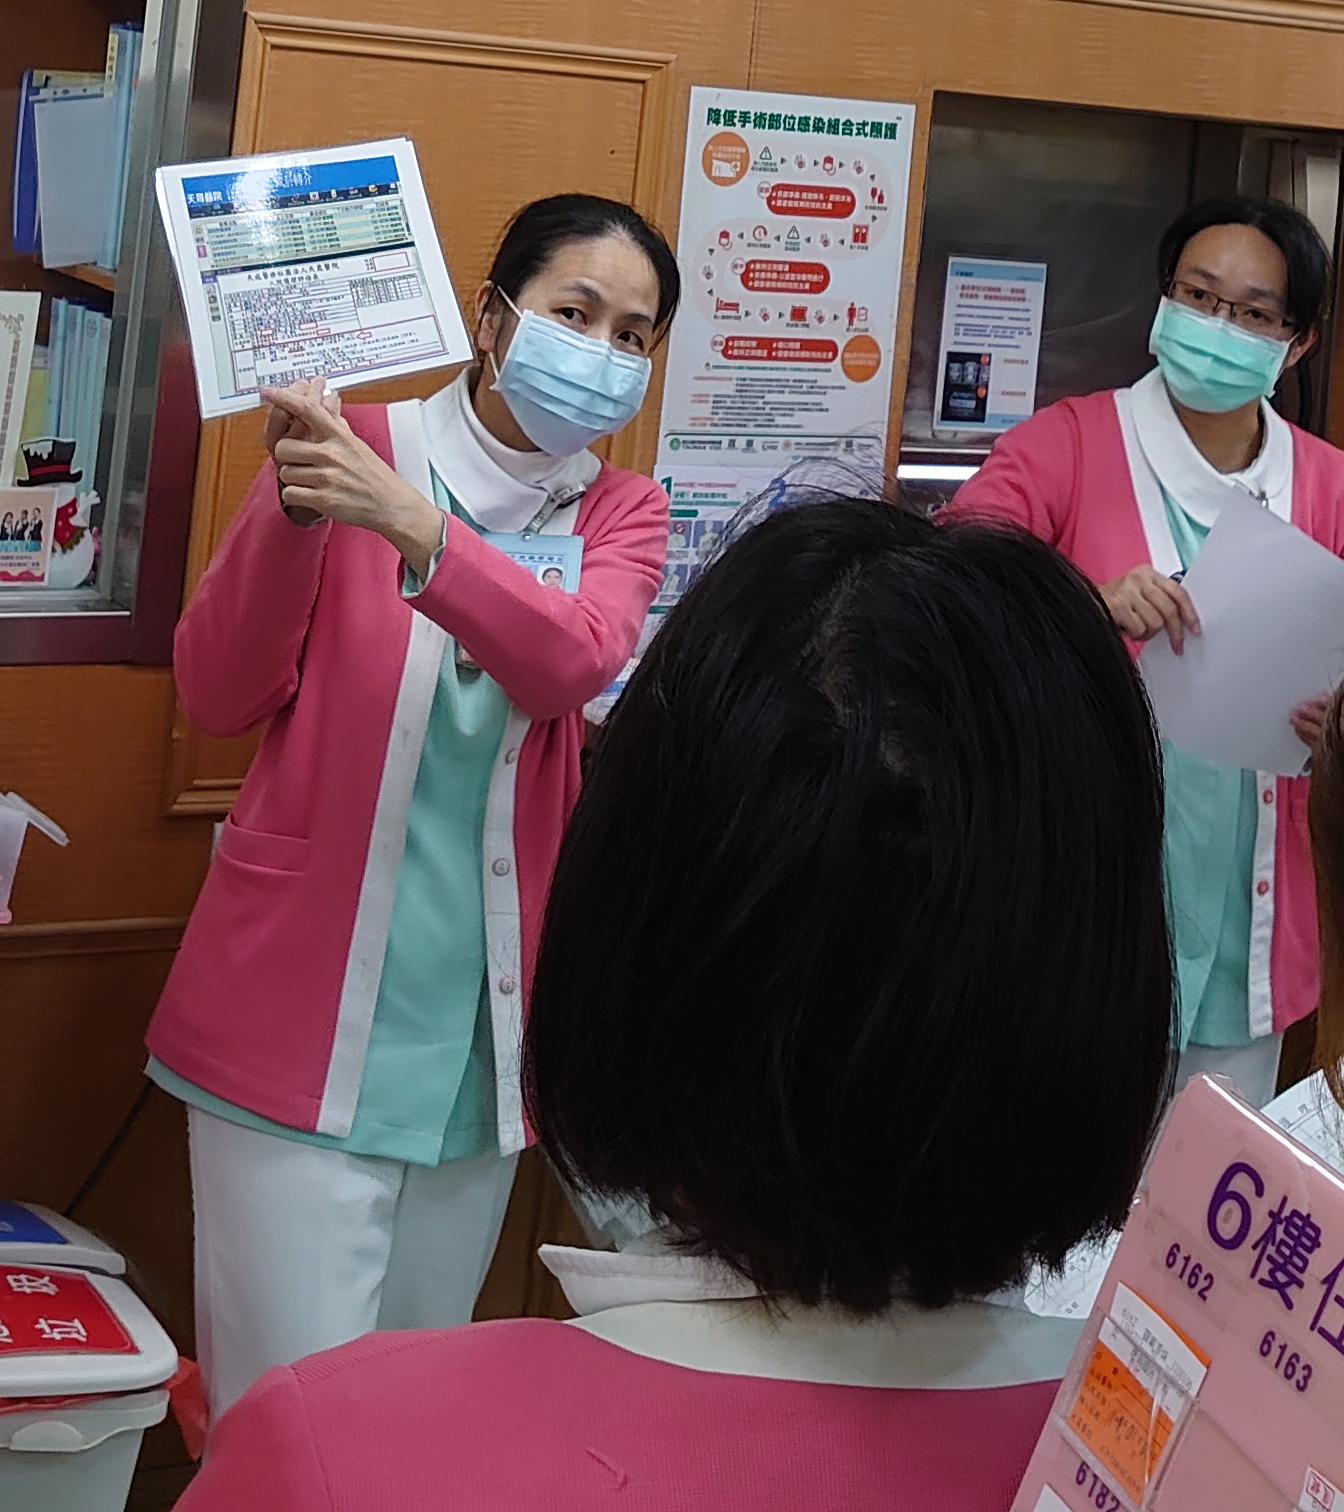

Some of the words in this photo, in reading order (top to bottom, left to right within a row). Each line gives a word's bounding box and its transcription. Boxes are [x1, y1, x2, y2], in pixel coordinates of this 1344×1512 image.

[705, 106, 900, 141] 降低手術部位感染組合式照護
[1164, 1241, 1215, 1302] 6162
[5, 1273, 88, 1343] 垃圾
[1258, 1329, 1314, 1393] 6163
